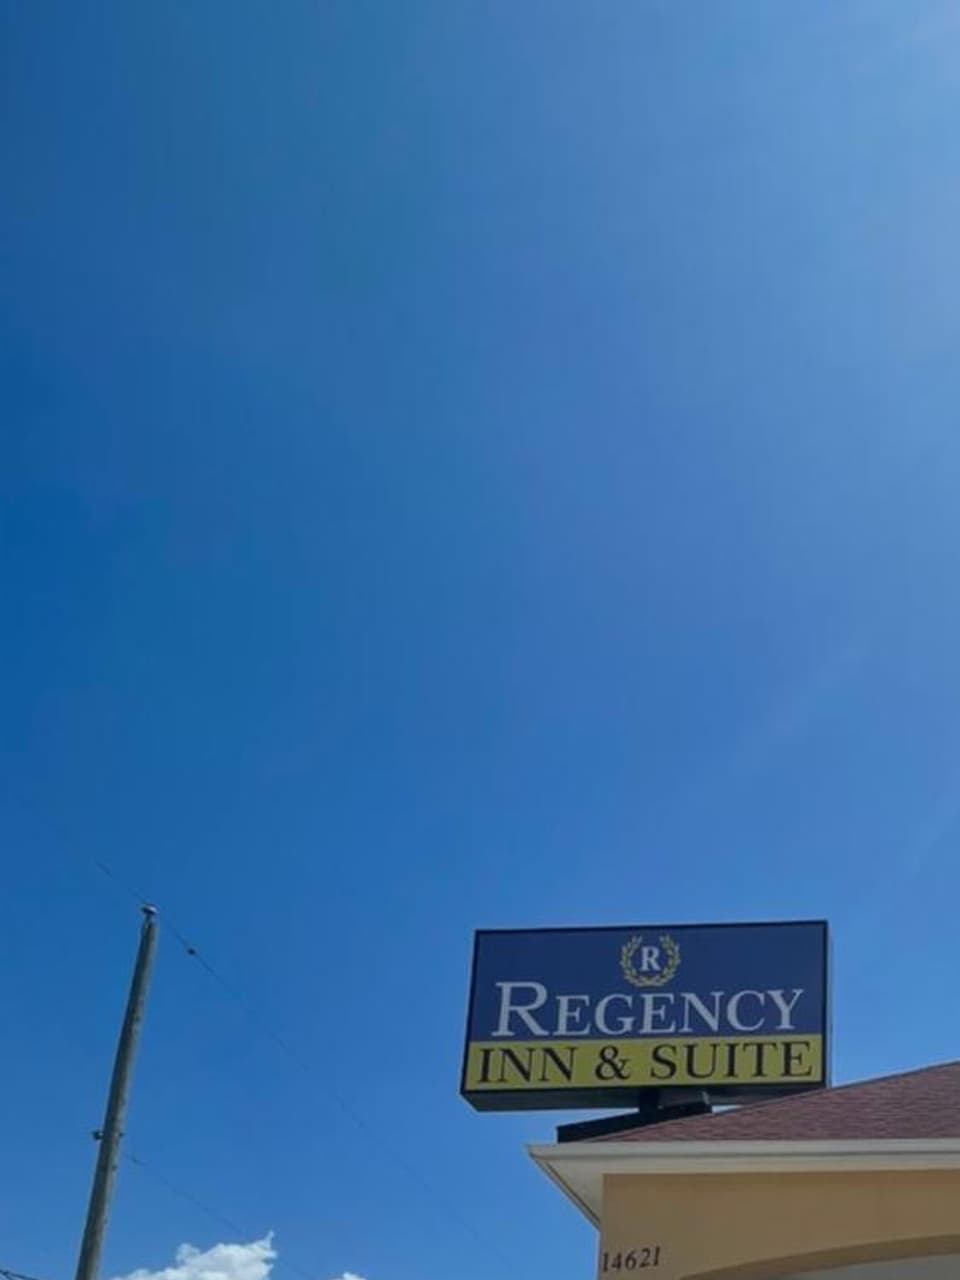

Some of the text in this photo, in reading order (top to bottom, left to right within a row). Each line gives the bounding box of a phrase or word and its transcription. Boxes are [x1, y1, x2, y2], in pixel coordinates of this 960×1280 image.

[640, 946, 661, 972] R
[491, 981, 805, 1037] REGENCY
[477, 1041, 812, 1083] INN & SUITE
[603, 1246, 661, 1272] 14621
